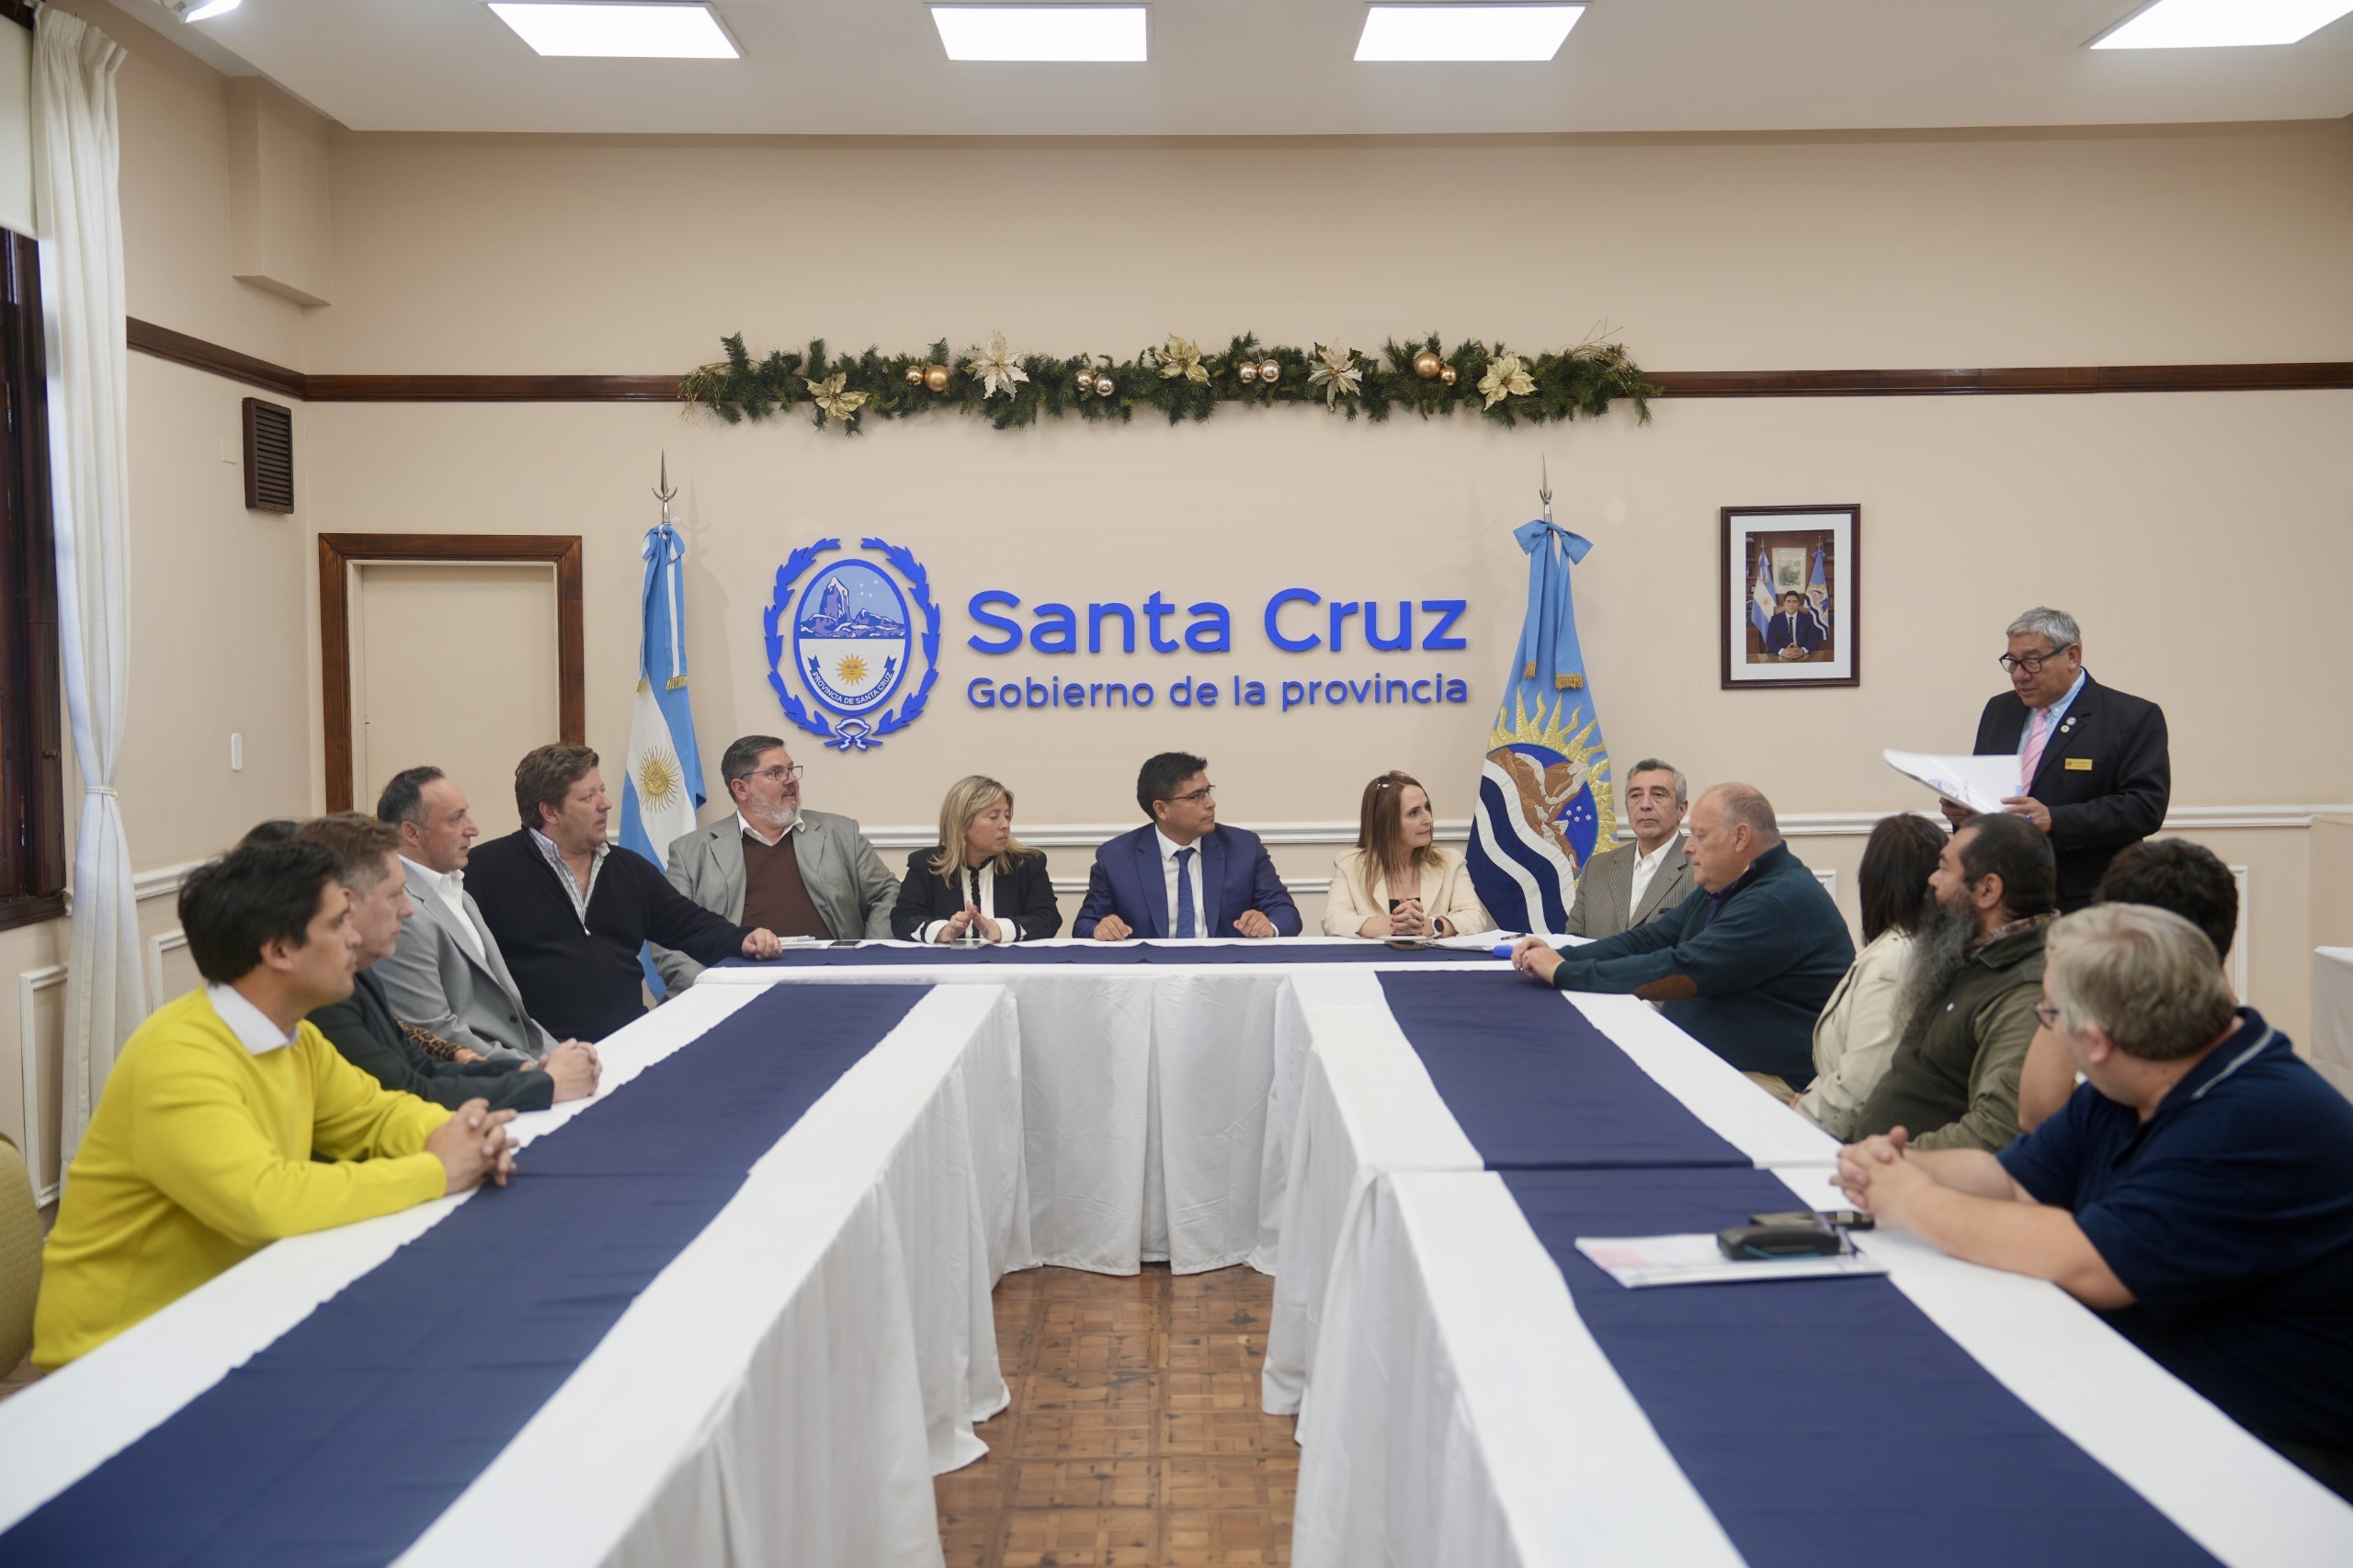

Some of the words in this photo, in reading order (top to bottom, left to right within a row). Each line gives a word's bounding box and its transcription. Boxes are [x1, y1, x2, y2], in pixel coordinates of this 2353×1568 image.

[968, 589, 1231, 654] Santa
[1264, 588, 1468, 653] Cruz
[812, 671, 842, 703] PROVINCIA
[856, 690, 880, 704] SANTA
[878, 672, 892, 691] CRUZ
[968, 676, 1154, 708] Gobierno
[1170, 676, 1219, 707] de
[1234, 676, 1266, 706] la
[1282, 673, 1468, 711] provincia
